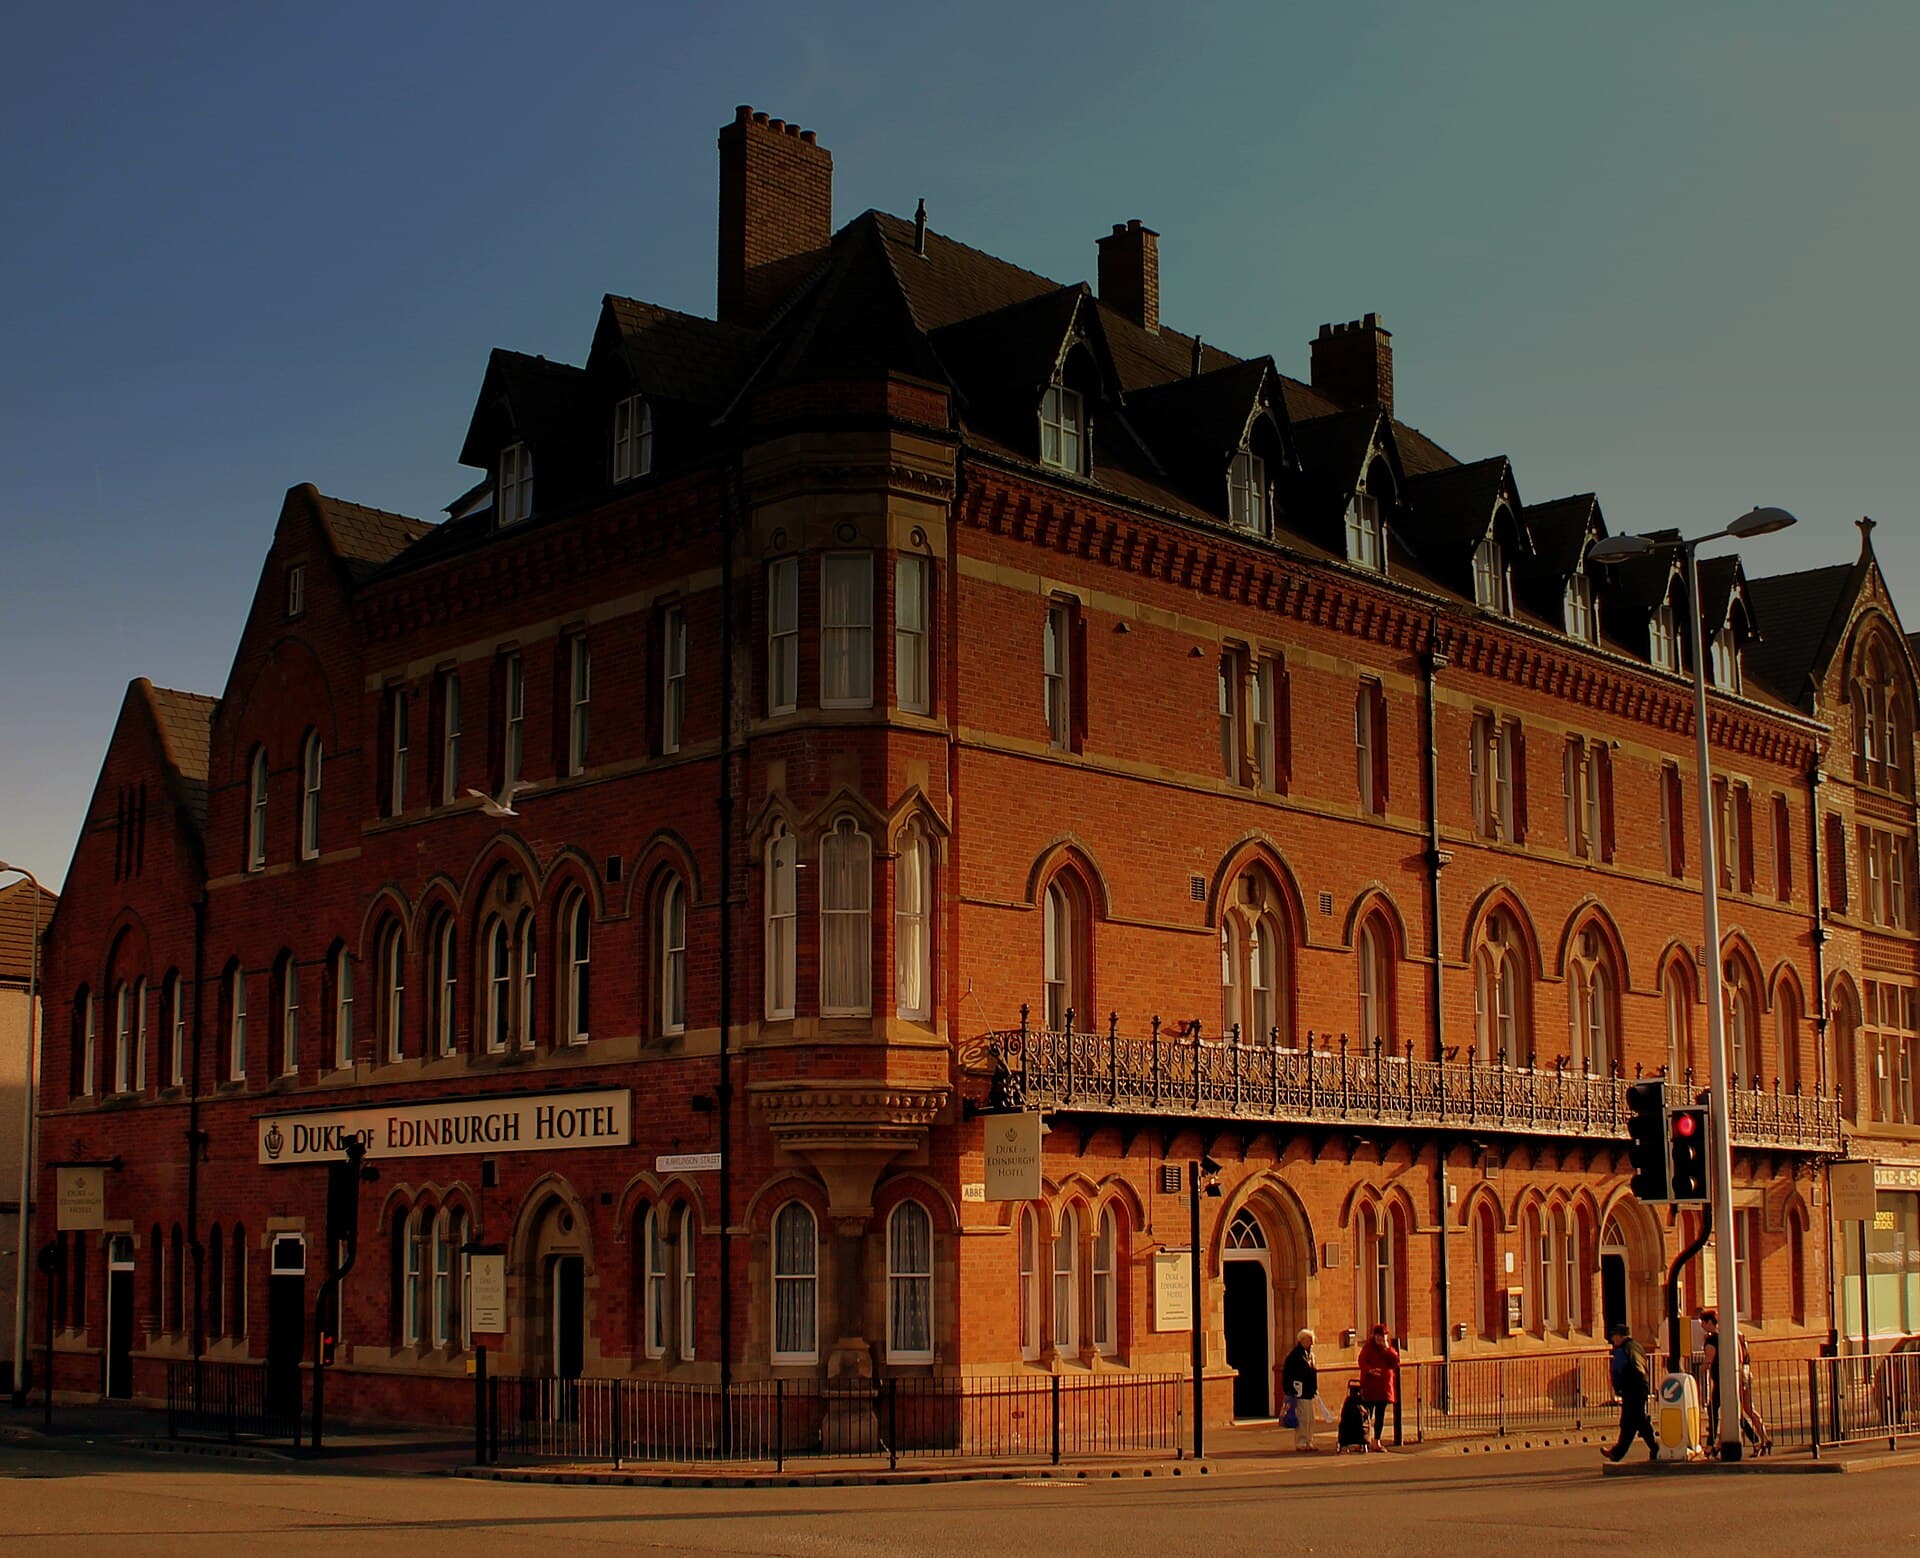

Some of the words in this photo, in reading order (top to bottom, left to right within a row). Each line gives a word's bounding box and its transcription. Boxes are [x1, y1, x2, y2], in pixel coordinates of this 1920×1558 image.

[292, 1124, 345, 1154] DUKE
[355, 1129, 374, 1149] OF
[386, 1113, 519, 1148] EDINBURGH
[535, 1105, 618, 1140] HOTEL
[996, 1145, 1017, 1154] DUKE
[987, 1156, 1035, 1167] EDINBURGH
[998, 1168, 1023, 1176] HOTEL
[964, 1187, 984, 1197] ABBE
